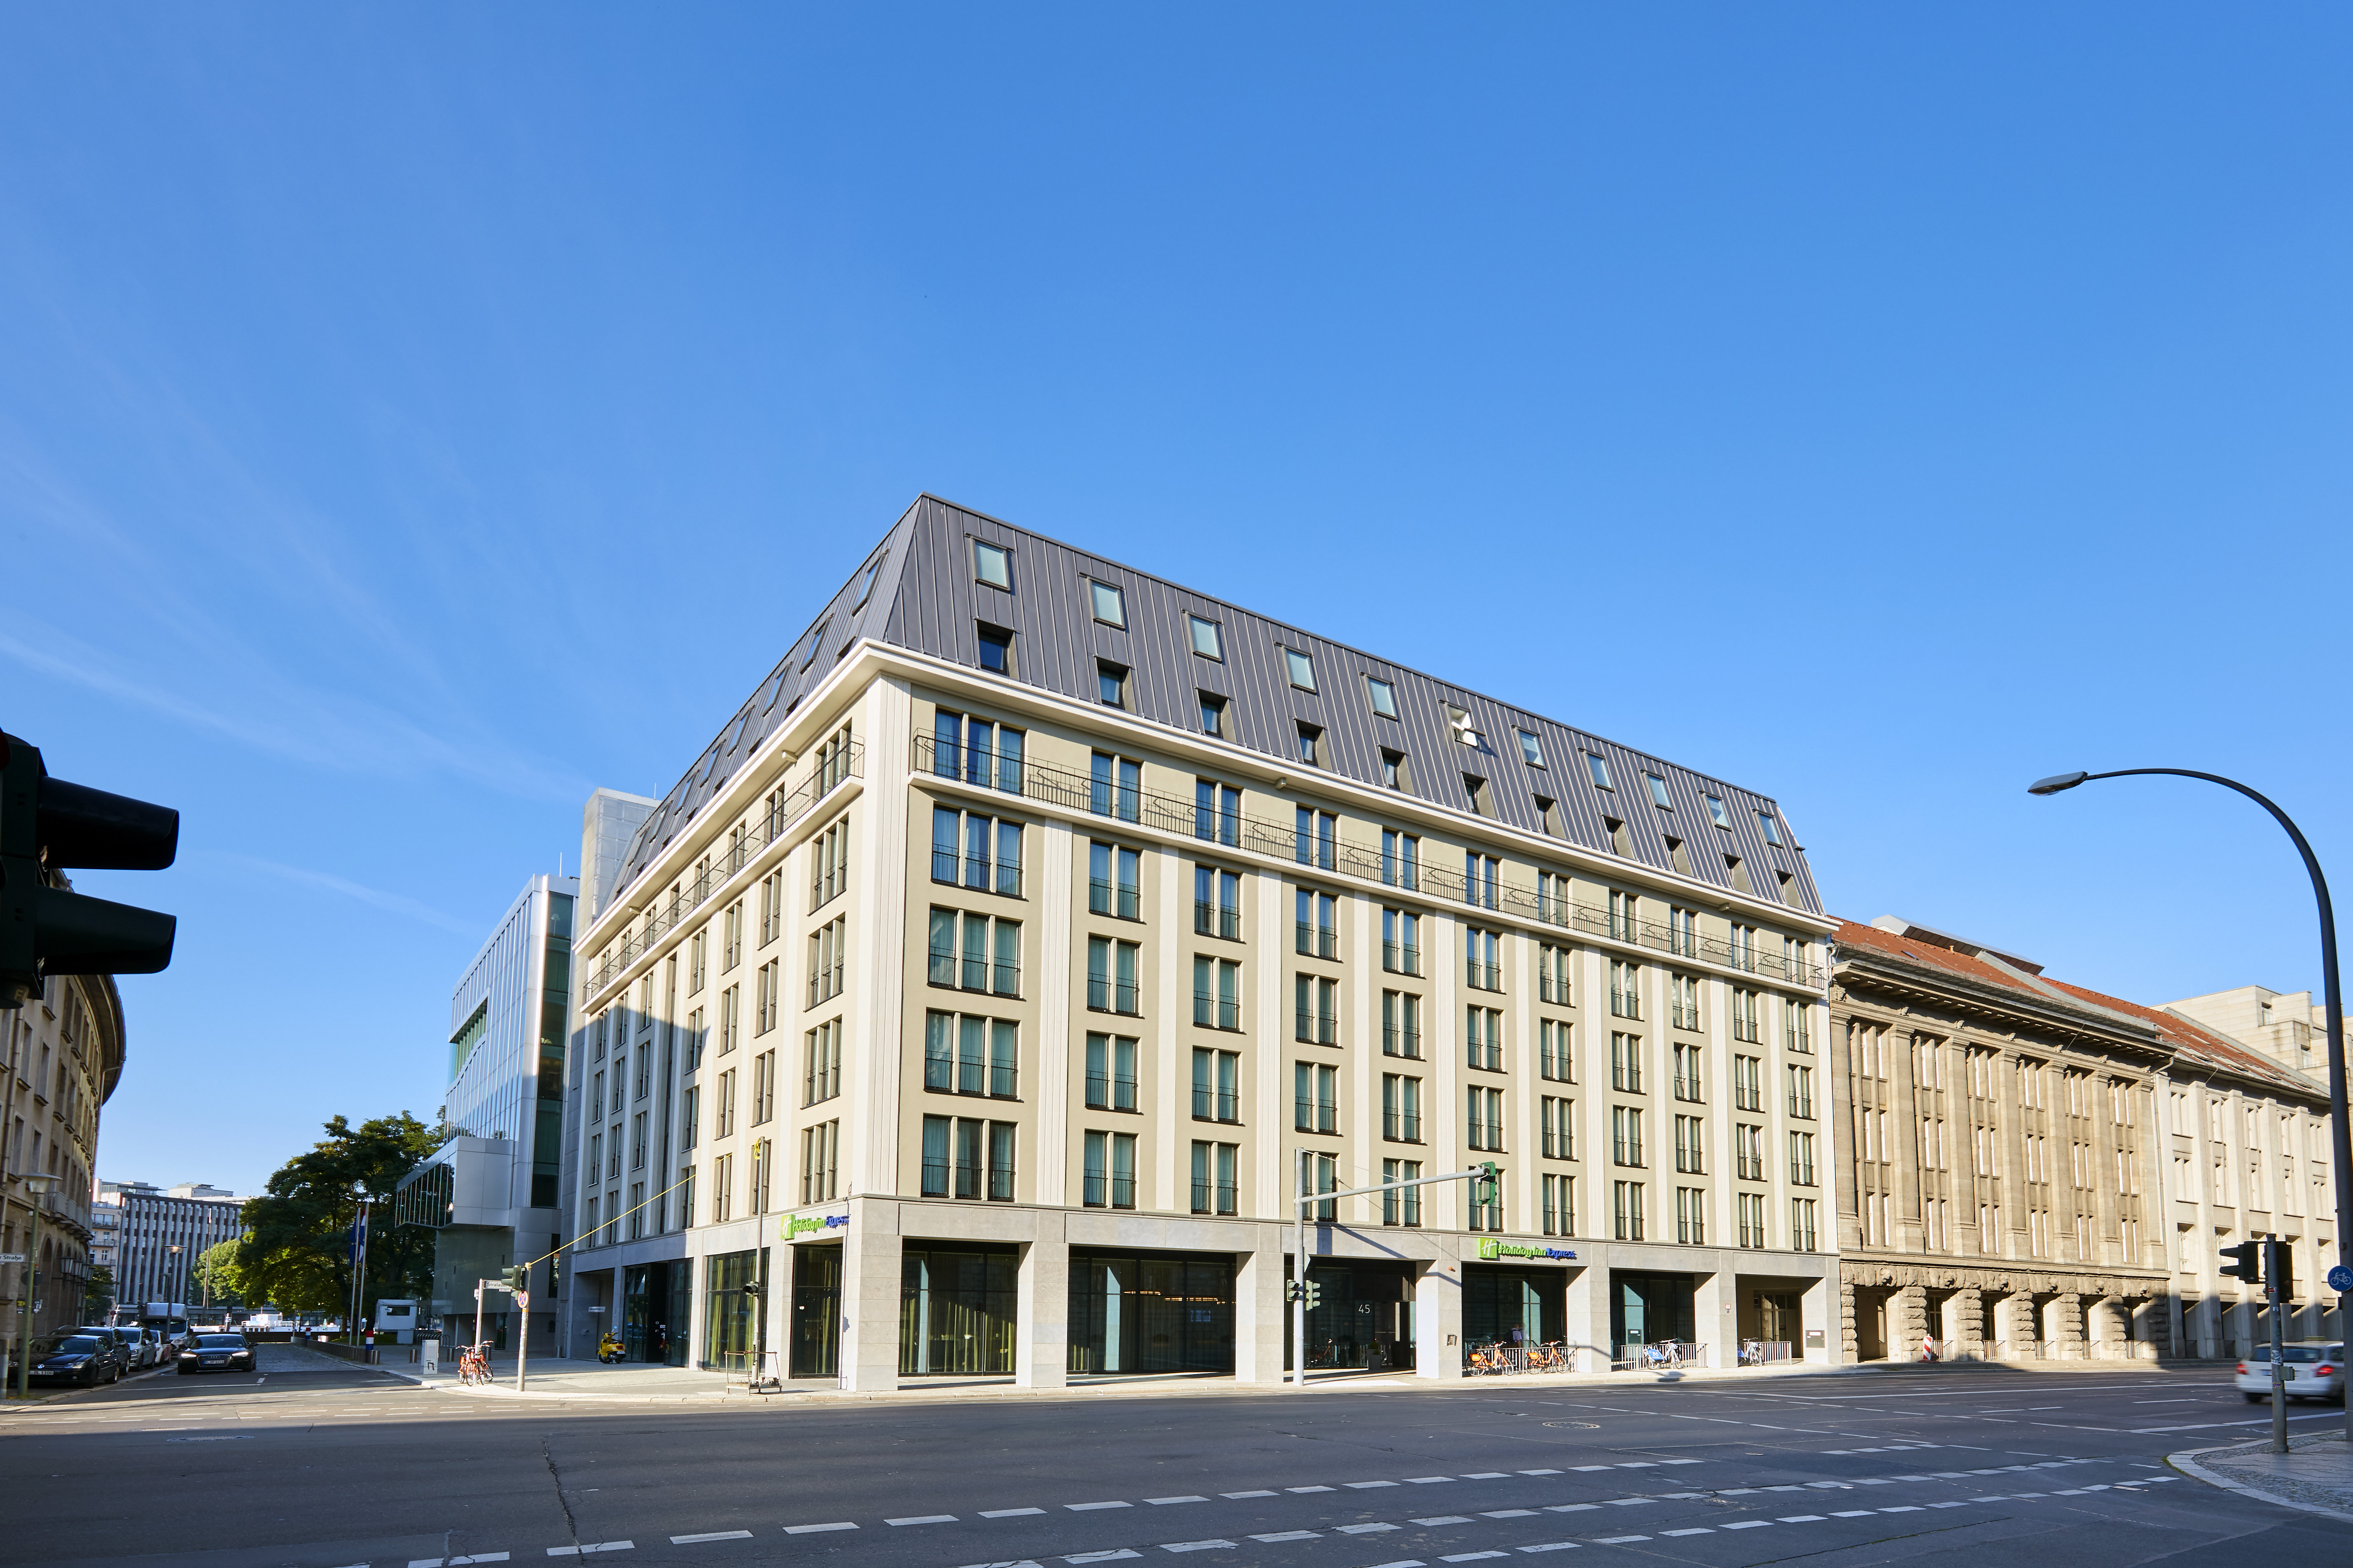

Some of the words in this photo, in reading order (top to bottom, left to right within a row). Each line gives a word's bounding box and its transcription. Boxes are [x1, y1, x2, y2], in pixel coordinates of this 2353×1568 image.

[793, 1218, 815, 1232] Holiday
[815, 1218, 825, 1228] Inn
[1498, 1244, 1532, 1258] Holiday
[1532, 1245, 1547, 1256] Inn
[1546, 1248, 1575, 1259] Express
[1358, 1304, 1370, 1314] 45
